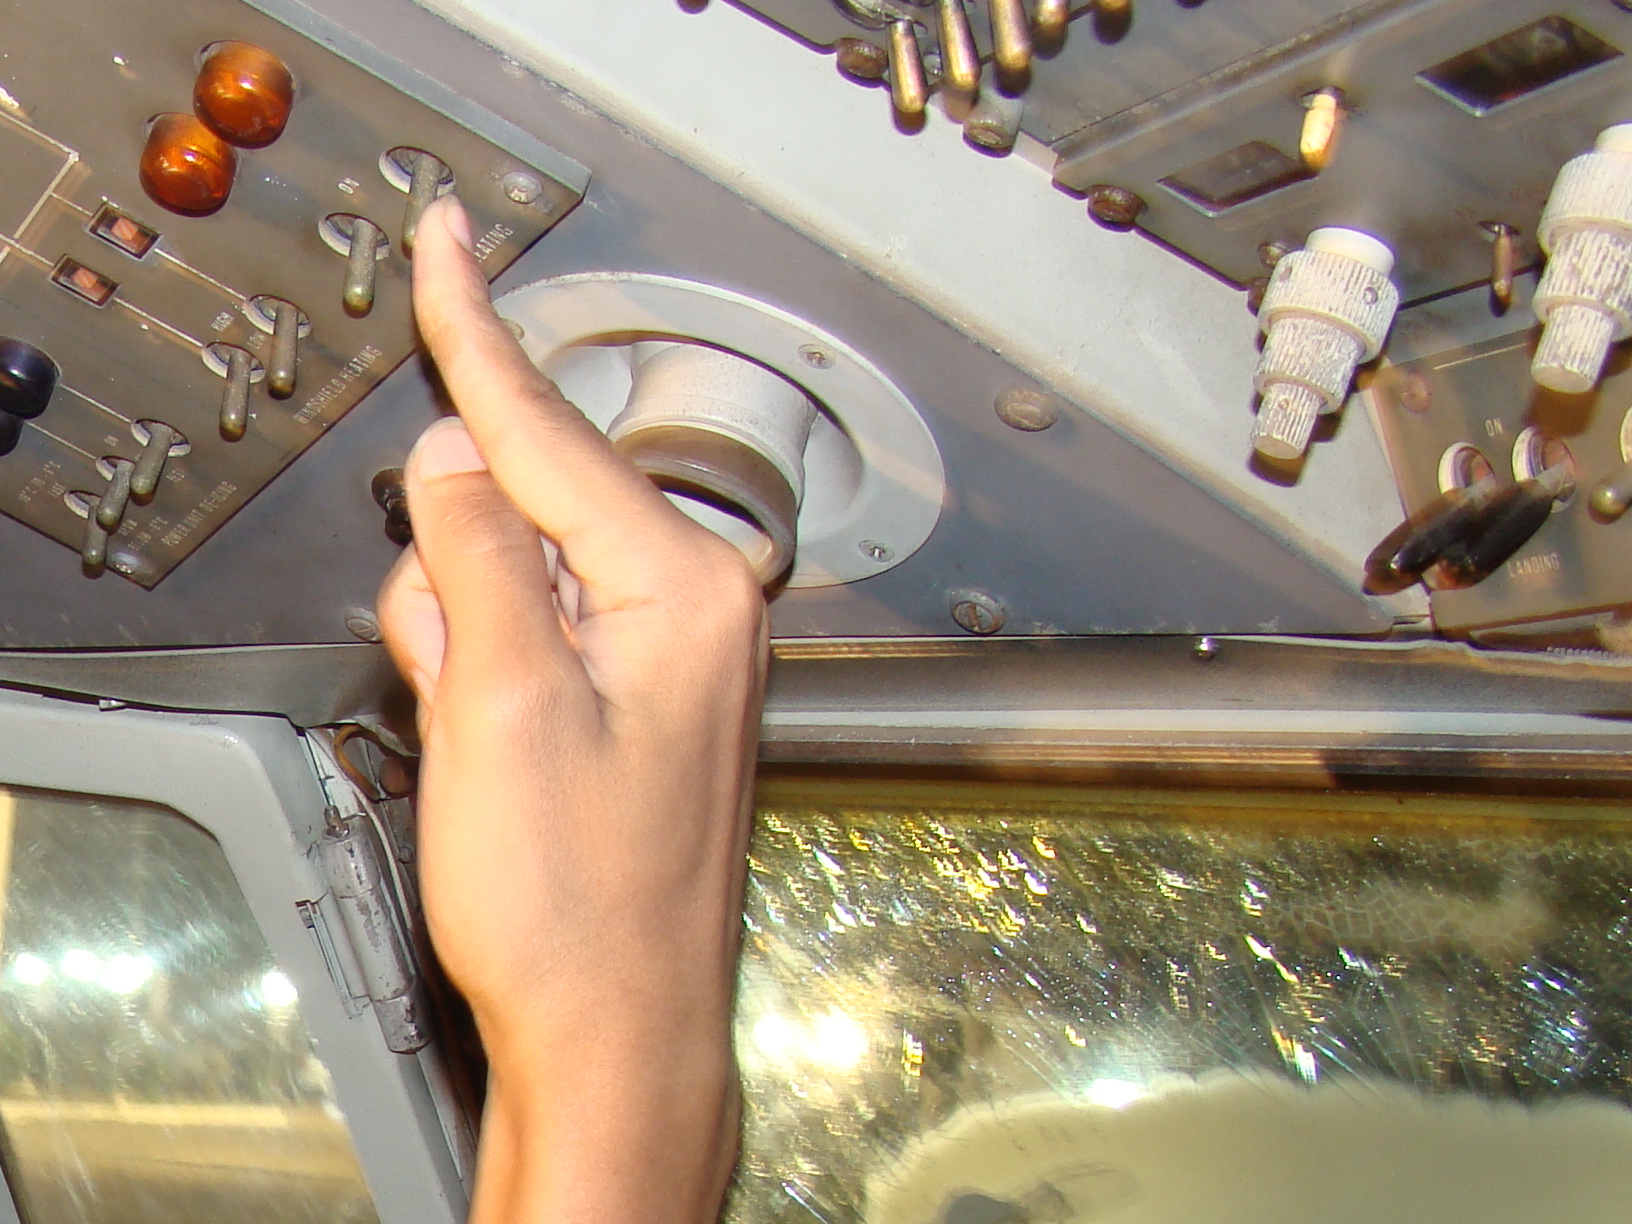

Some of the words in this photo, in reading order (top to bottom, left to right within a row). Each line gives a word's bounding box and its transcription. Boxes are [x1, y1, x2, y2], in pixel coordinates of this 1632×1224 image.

[337, 177, 360, 195] ON
[475, 223, 514, 263] EATING
[293, 378, 347, 426] WINDSHIELD
[339, 345, 384, 385] HEATING
[1485, 418, 1503, 437] ON
[1507, 553, 1560, 578] LANDING
